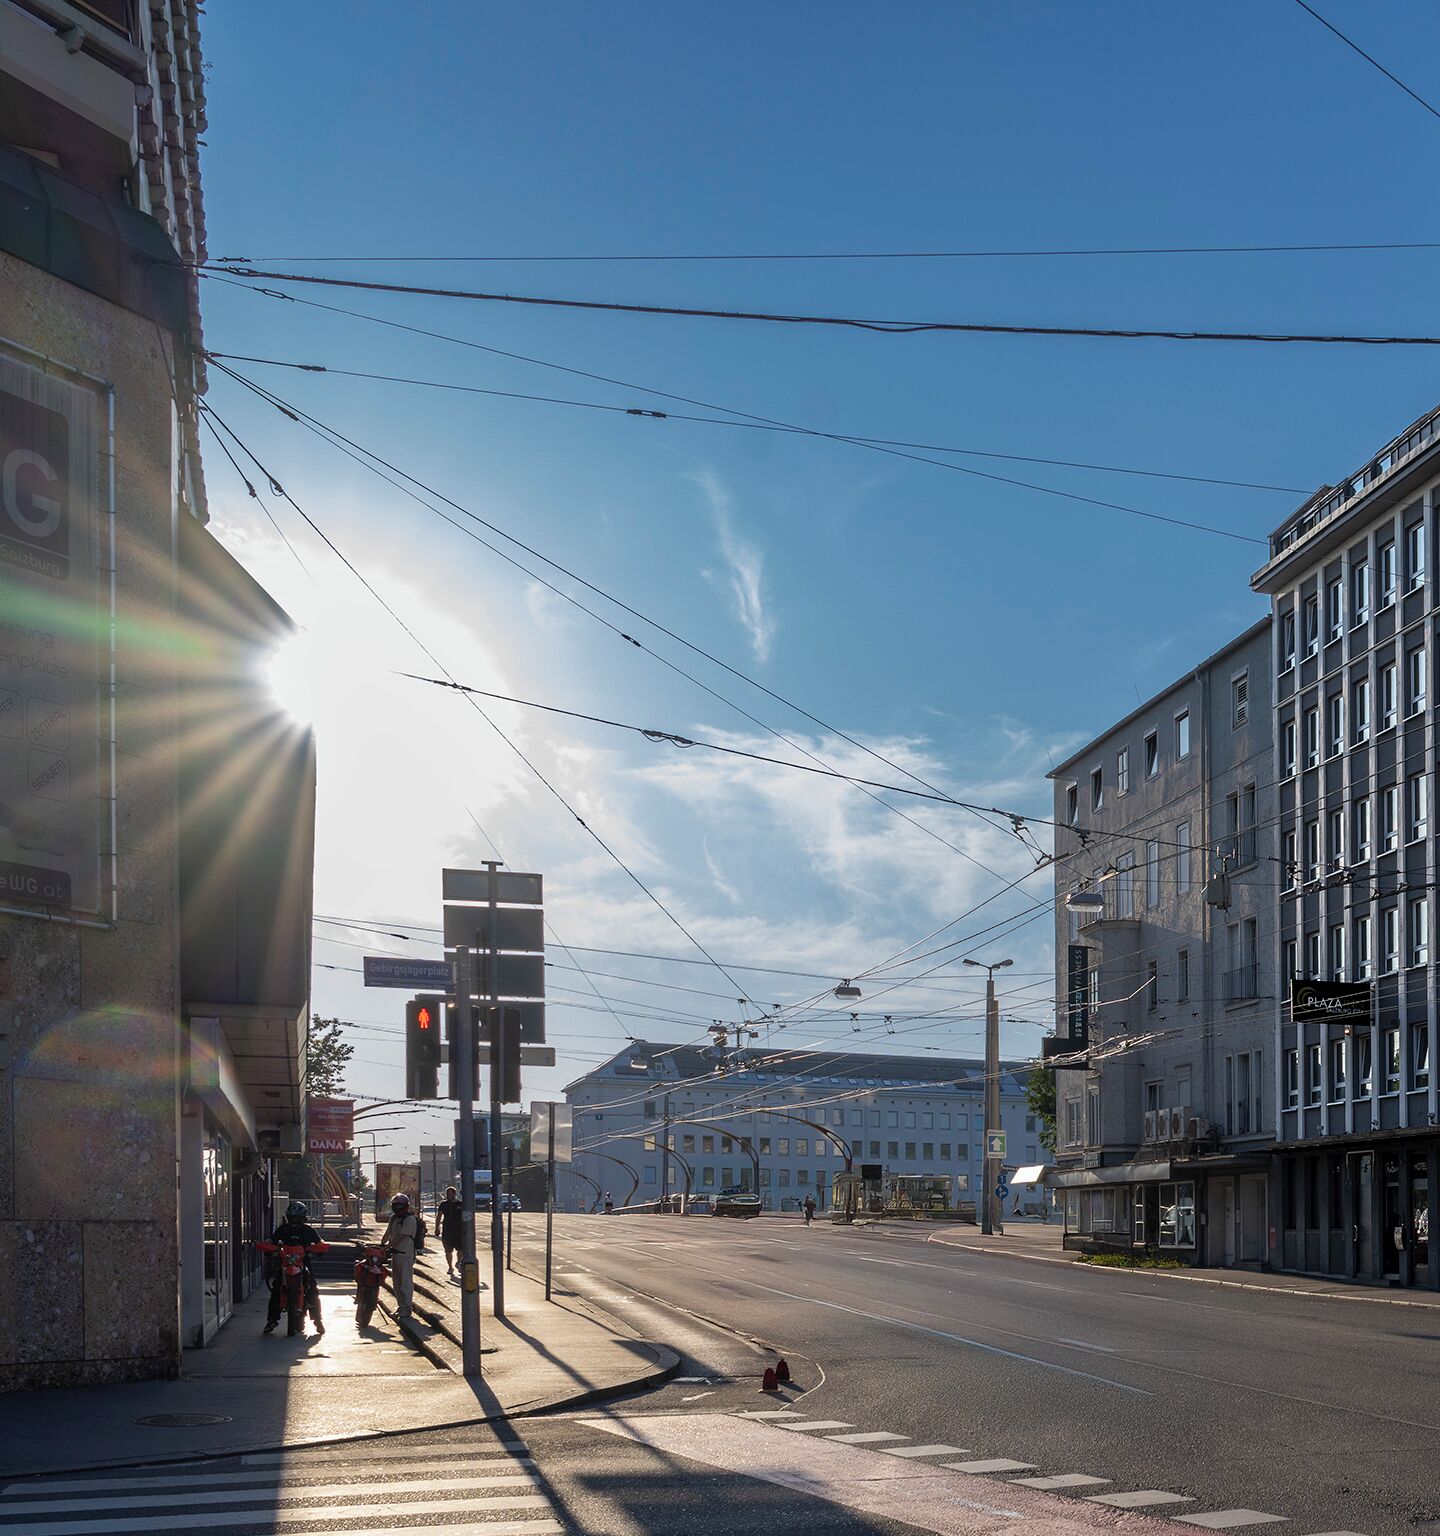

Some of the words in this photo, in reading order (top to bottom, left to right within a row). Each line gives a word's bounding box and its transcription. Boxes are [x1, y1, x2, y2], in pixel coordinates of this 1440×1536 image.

[0, 544, 61, 577] Salzburg
[0, 616, 54, 649] hnung
[0, 648, 70, 679] enplätze
[32, 759, 67, 791] BEQUEM
[0, 874, 63, 898] eWG.at
[370, 963, 449, 977] Gebirgsjägerplatz
[1308, 996, 1343, 1008] PLAZA
[310, 1139, 344, 1150] DANA
